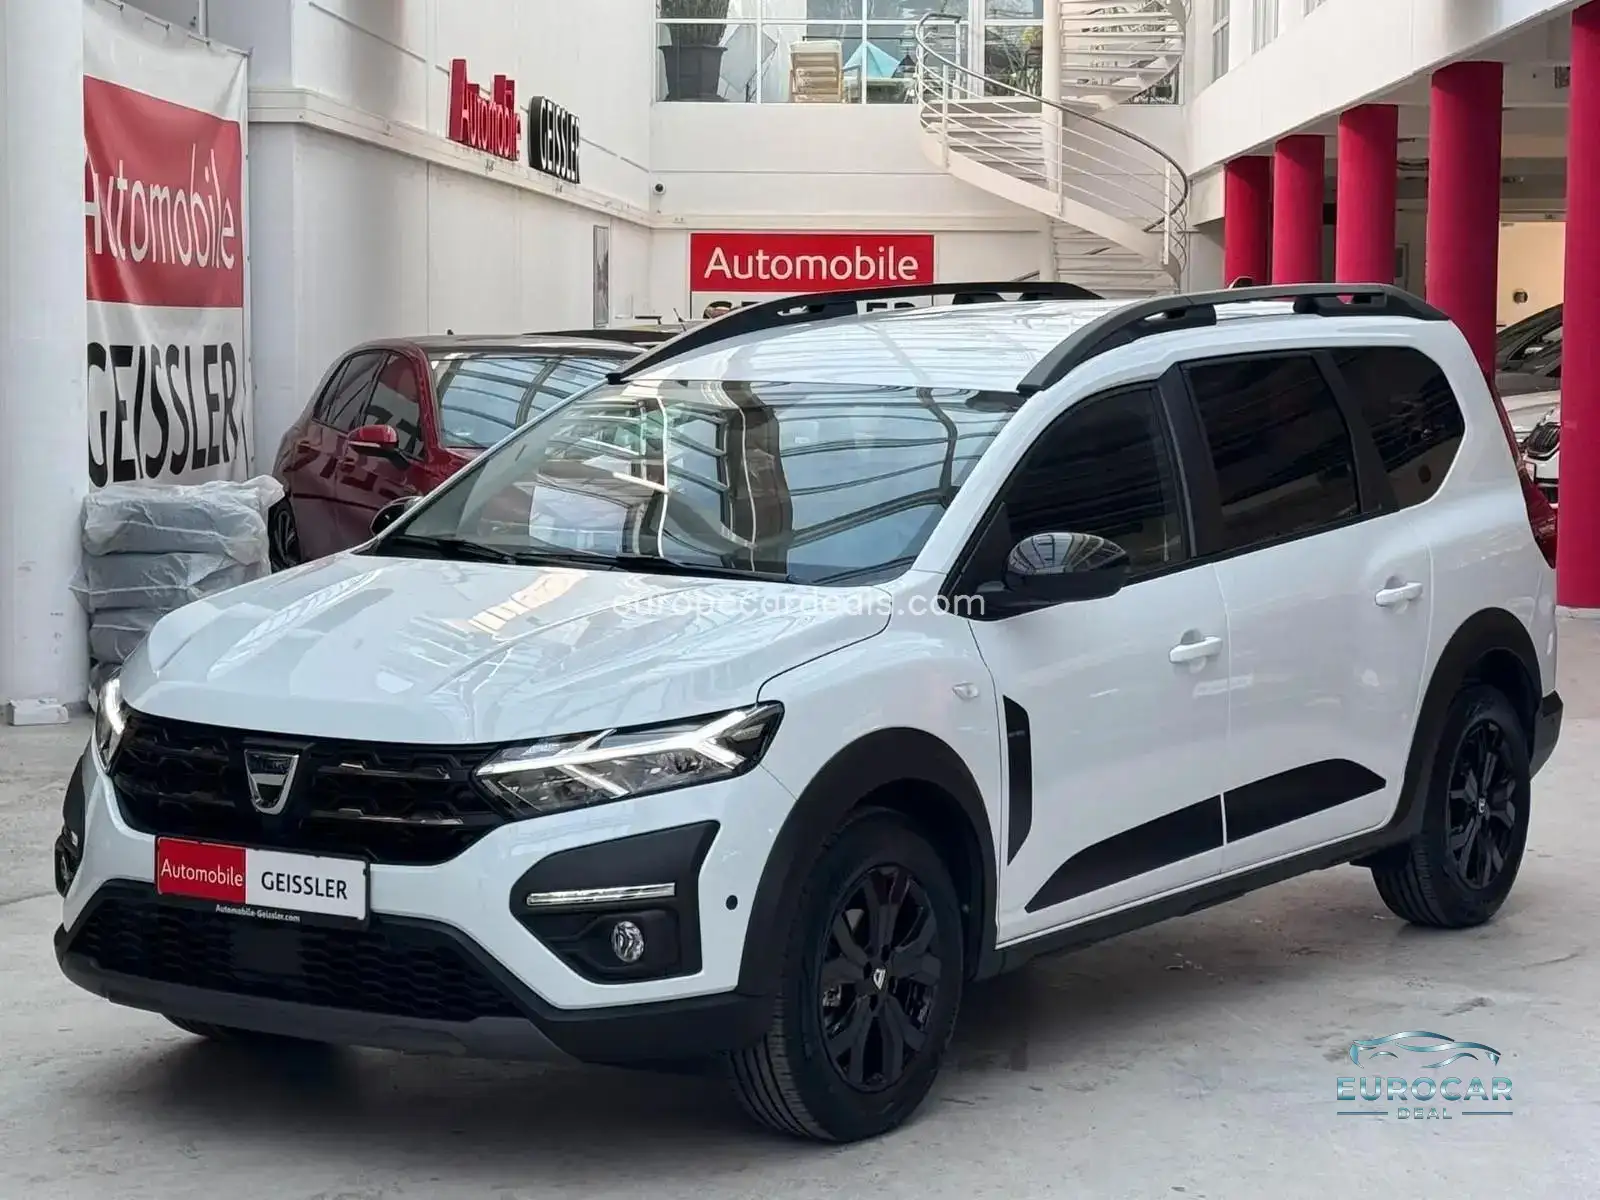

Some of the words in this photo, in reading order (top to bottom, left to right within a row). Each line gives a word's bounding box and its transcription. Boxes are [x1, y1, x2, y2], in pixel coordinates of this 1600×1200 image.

[450, 59, 522, 161] Automobile
[528, 96, 581, 184] GEISSLER
[704, 246, 919, 280] Automobile
[87, 342, 238, 488] GEISSLER
[161, 859, 244, 887] Automobile
[261, 871, 348, 900] GEISSLER
